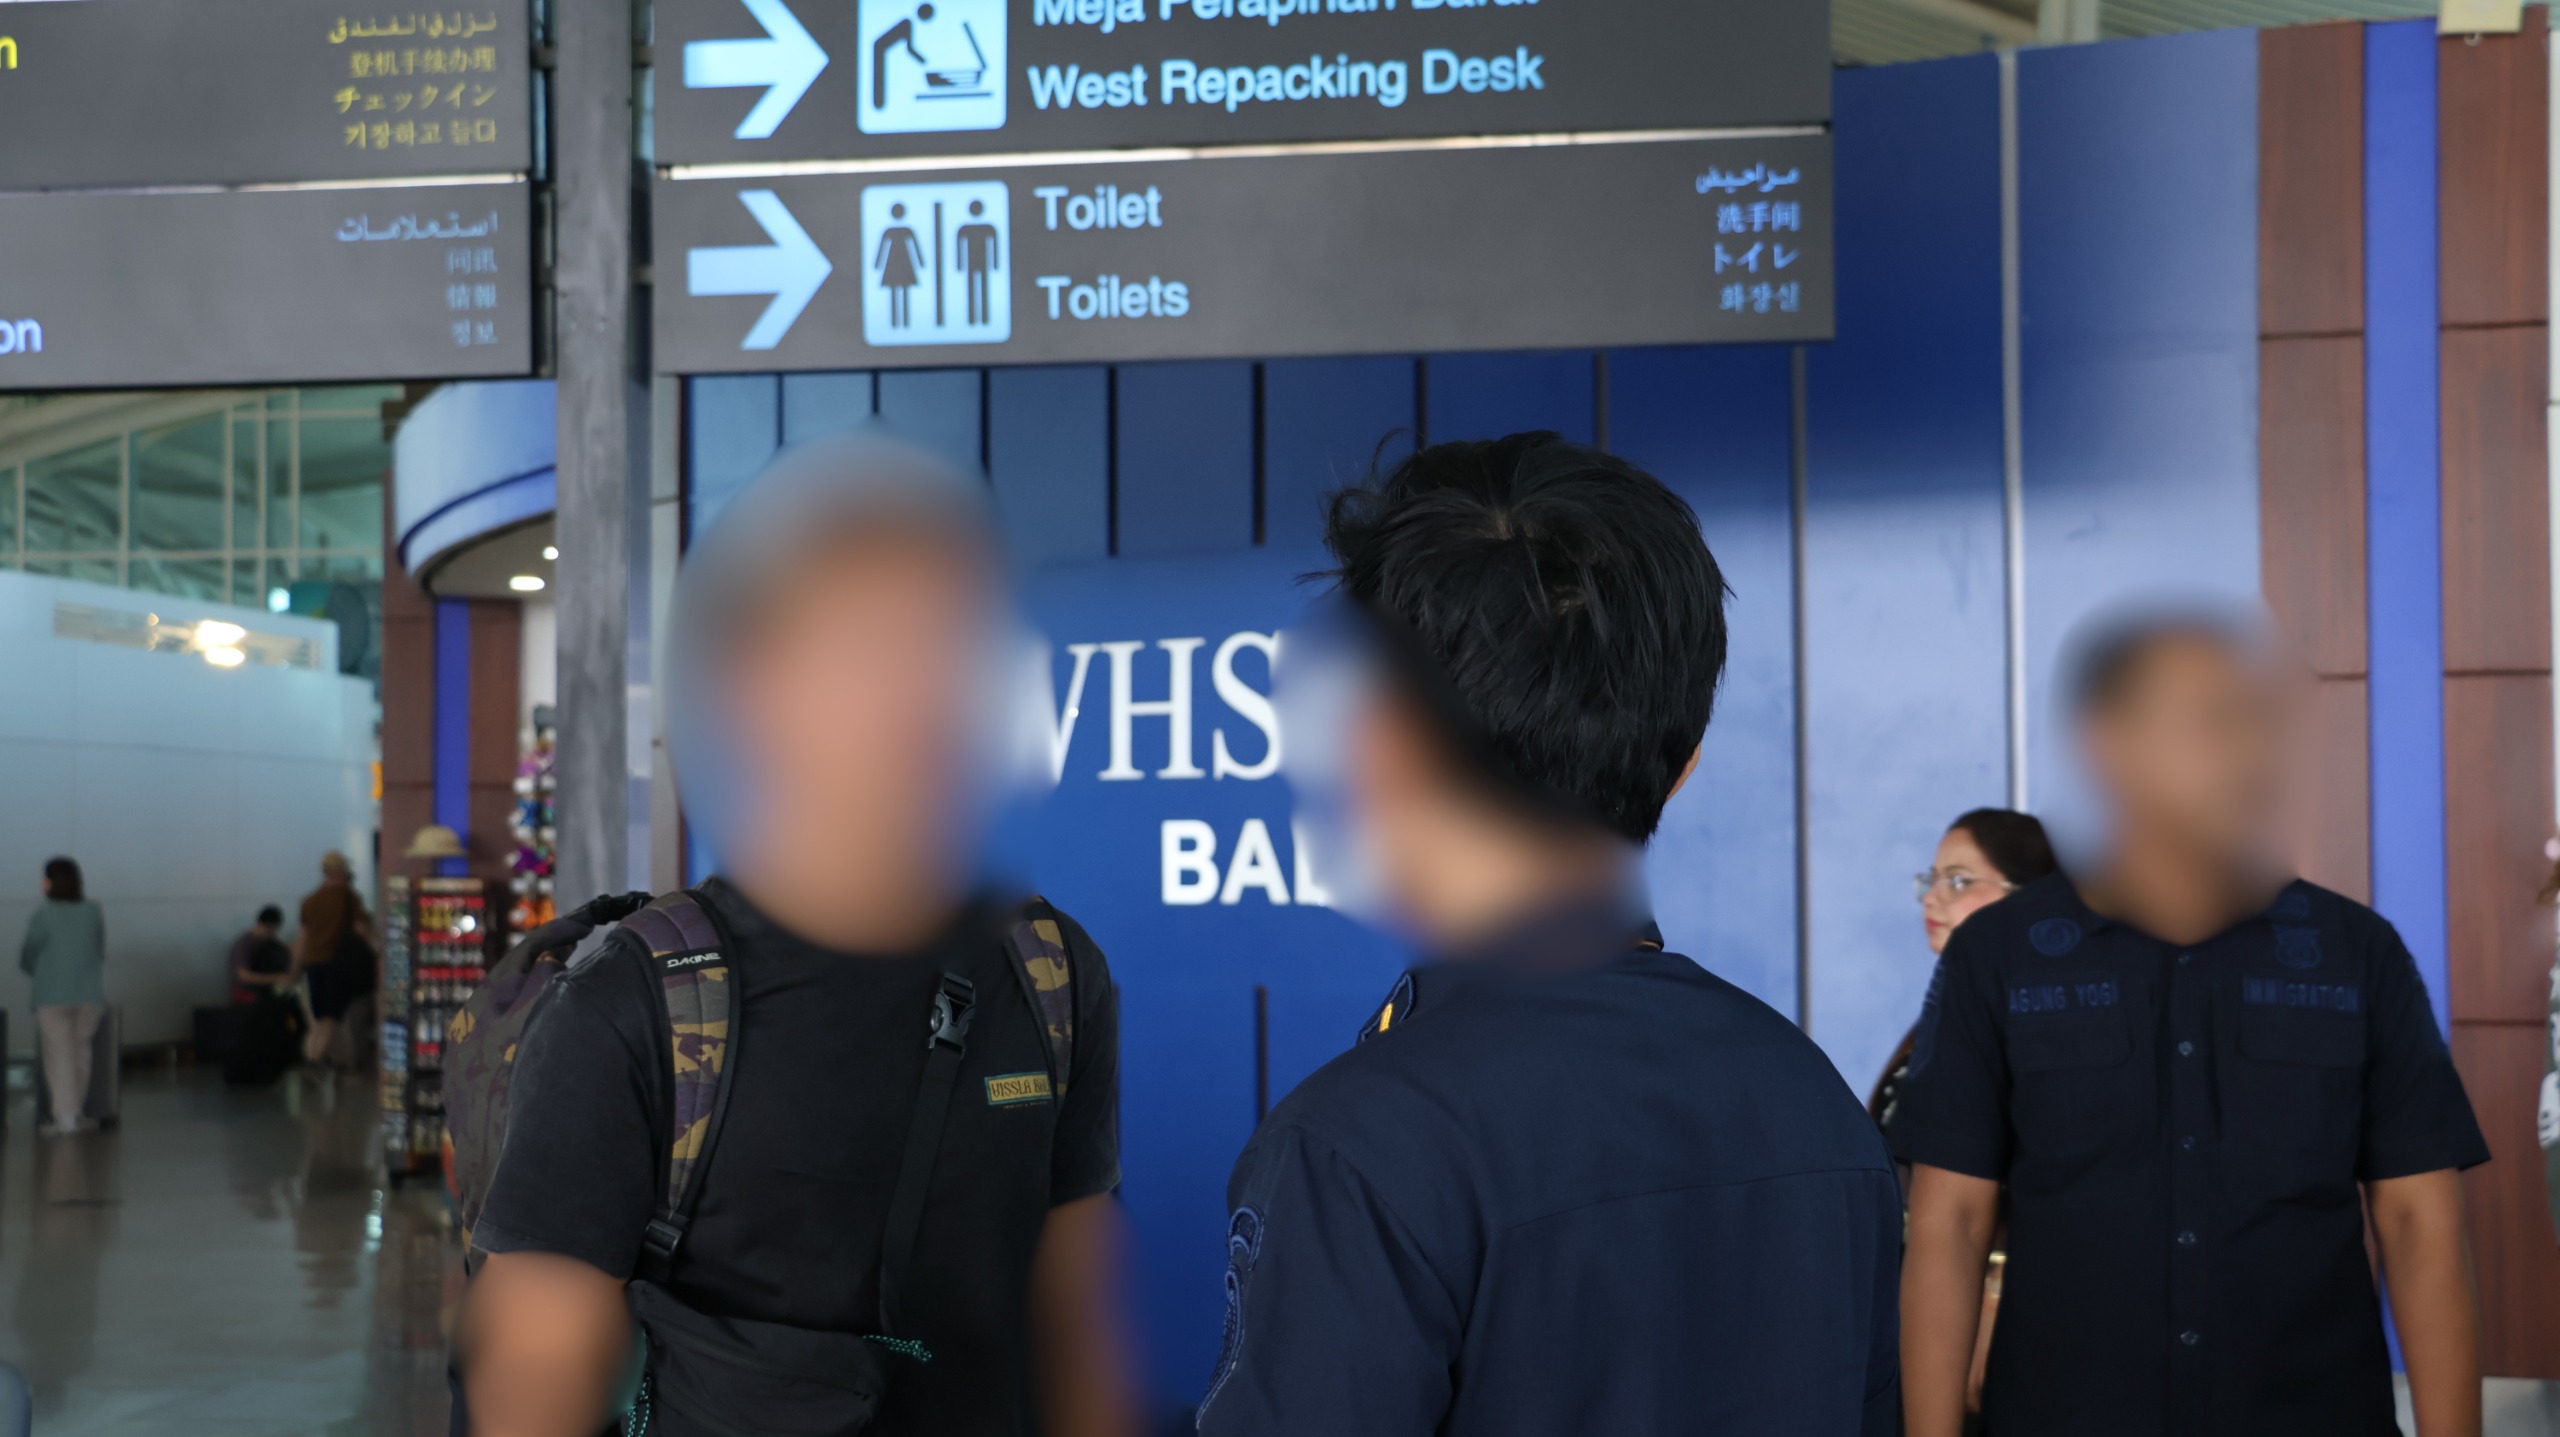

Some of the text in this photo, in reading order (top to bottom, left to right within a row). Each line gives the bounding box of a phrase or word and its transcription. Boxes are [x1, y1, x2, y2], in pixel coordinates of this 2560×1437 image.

[1027, 45, 1545, 113] West Repacking Desk
[1033, 184, 1163, 231] Toilet
[1713, 241, 1801, 274] トイレ
[1035, 273, 1190, 321] Toilets
[1718, 281, 1801, 314] 화장실
[666, 952, 722, 968] DAKINE
[2009, 978, 2120, 1014] AGUNG YOGI
[2242, 976, 2361, 1013] IMMIGRATION
